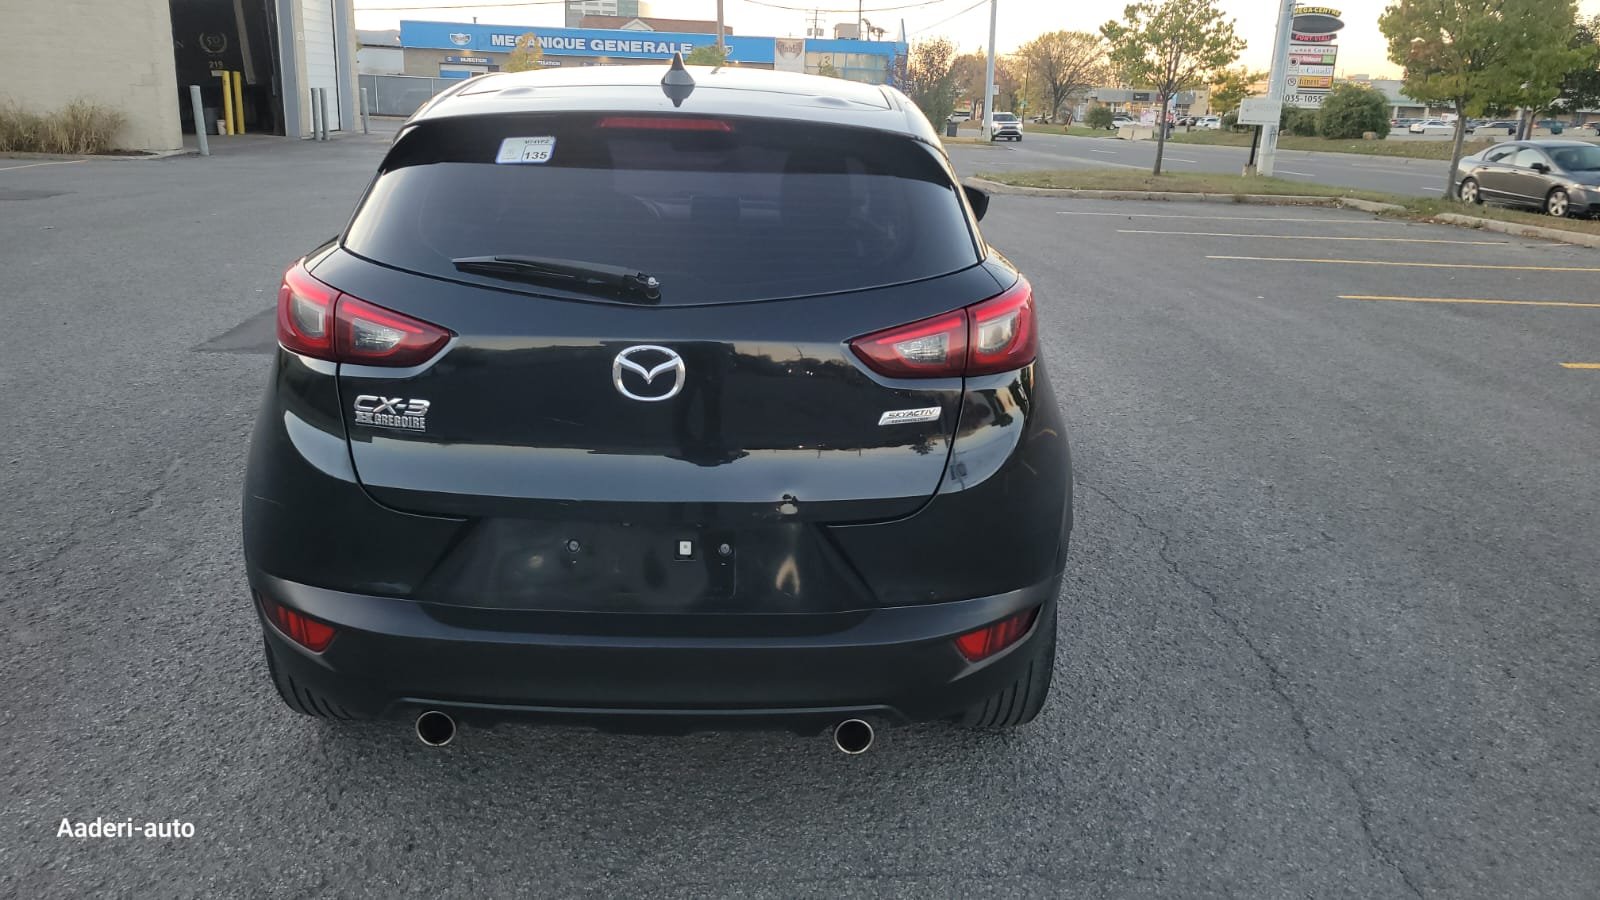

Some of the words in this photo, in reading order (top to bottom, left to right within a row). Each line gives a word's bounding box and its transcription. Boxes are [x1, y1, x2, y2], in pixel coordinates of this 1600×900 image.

[491, 34, 586, 50] MECANIQUE
[590, 38, 693, 54] GENERALE
[525, 151, 548, 160] 135
[353, 394, 431, 416] CX-3
[888, 408, 936, 418] SKYACTIV
